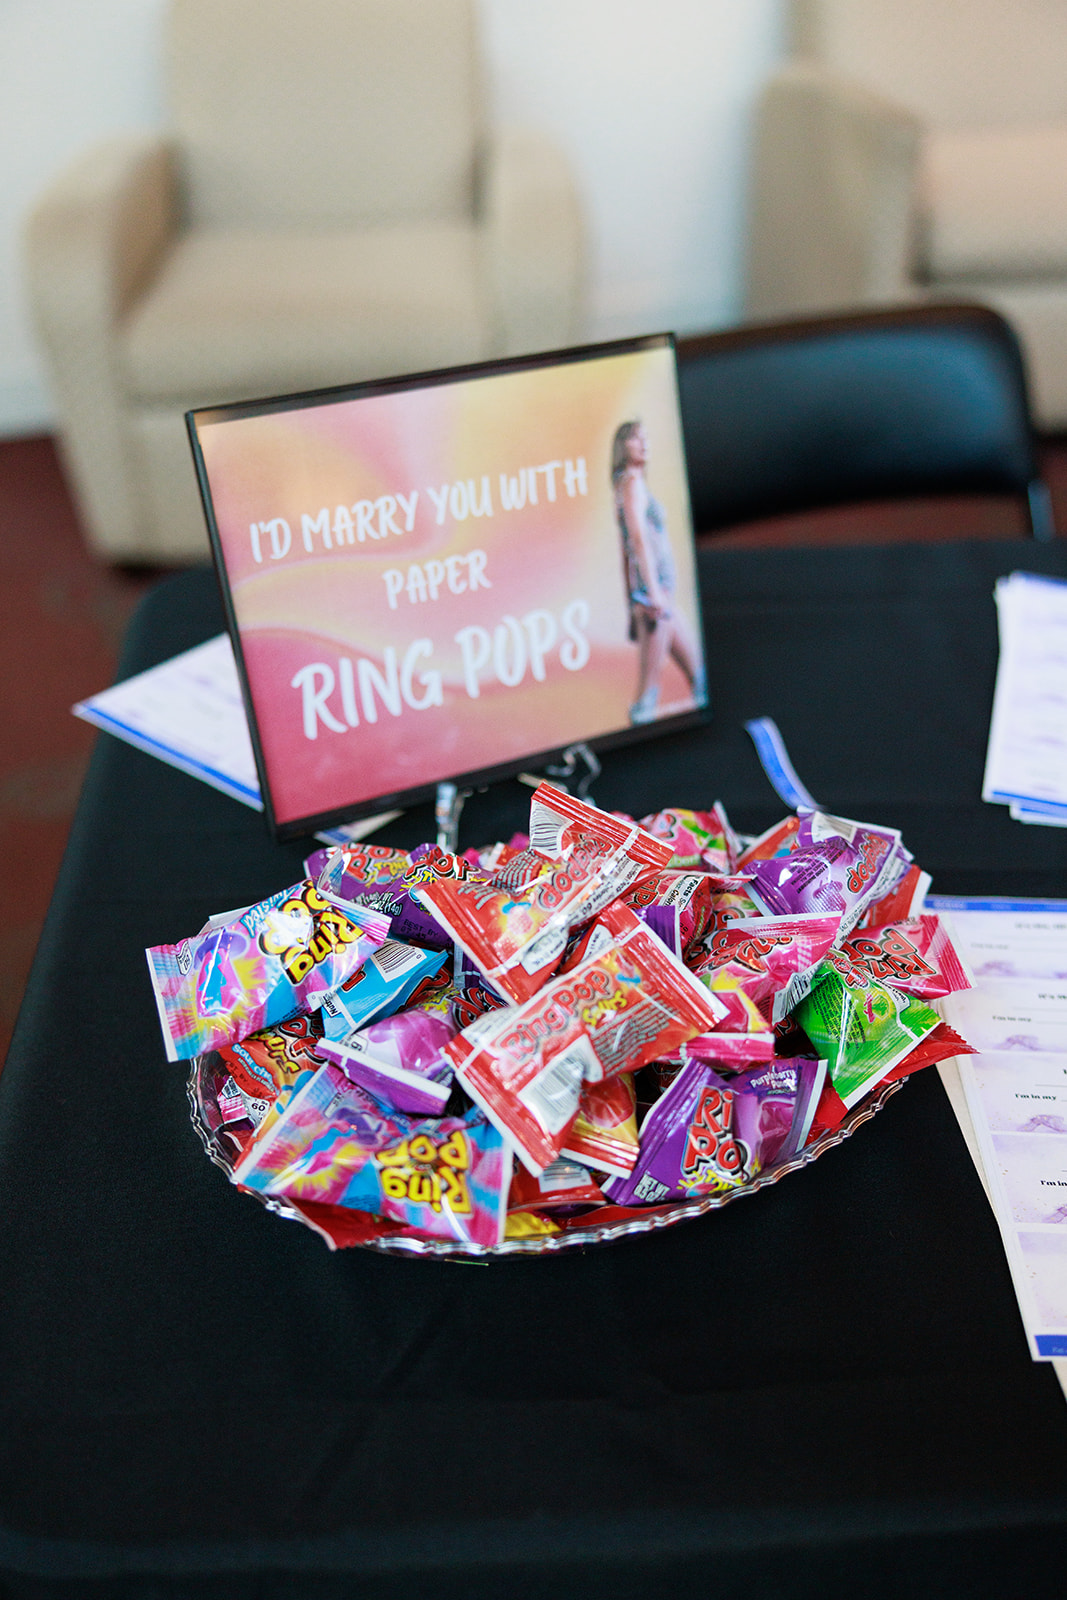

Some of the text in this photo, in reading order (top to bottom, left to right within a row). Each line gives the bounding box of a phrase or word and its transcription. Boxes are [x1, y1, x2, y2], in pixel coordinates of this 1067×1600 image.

[249, 457, 589, 563] I'D MARRY YOU WITH
[382, 549, 493, 610] PAPER
[290, 599, 591, 741] RING POPS
[242, 886, 300, 938] Twisted
[694, 1087, 734, 1135] Ri
[683, 1126, 743, 1174] Po
[380, 1165, 472, 1214] Ring
